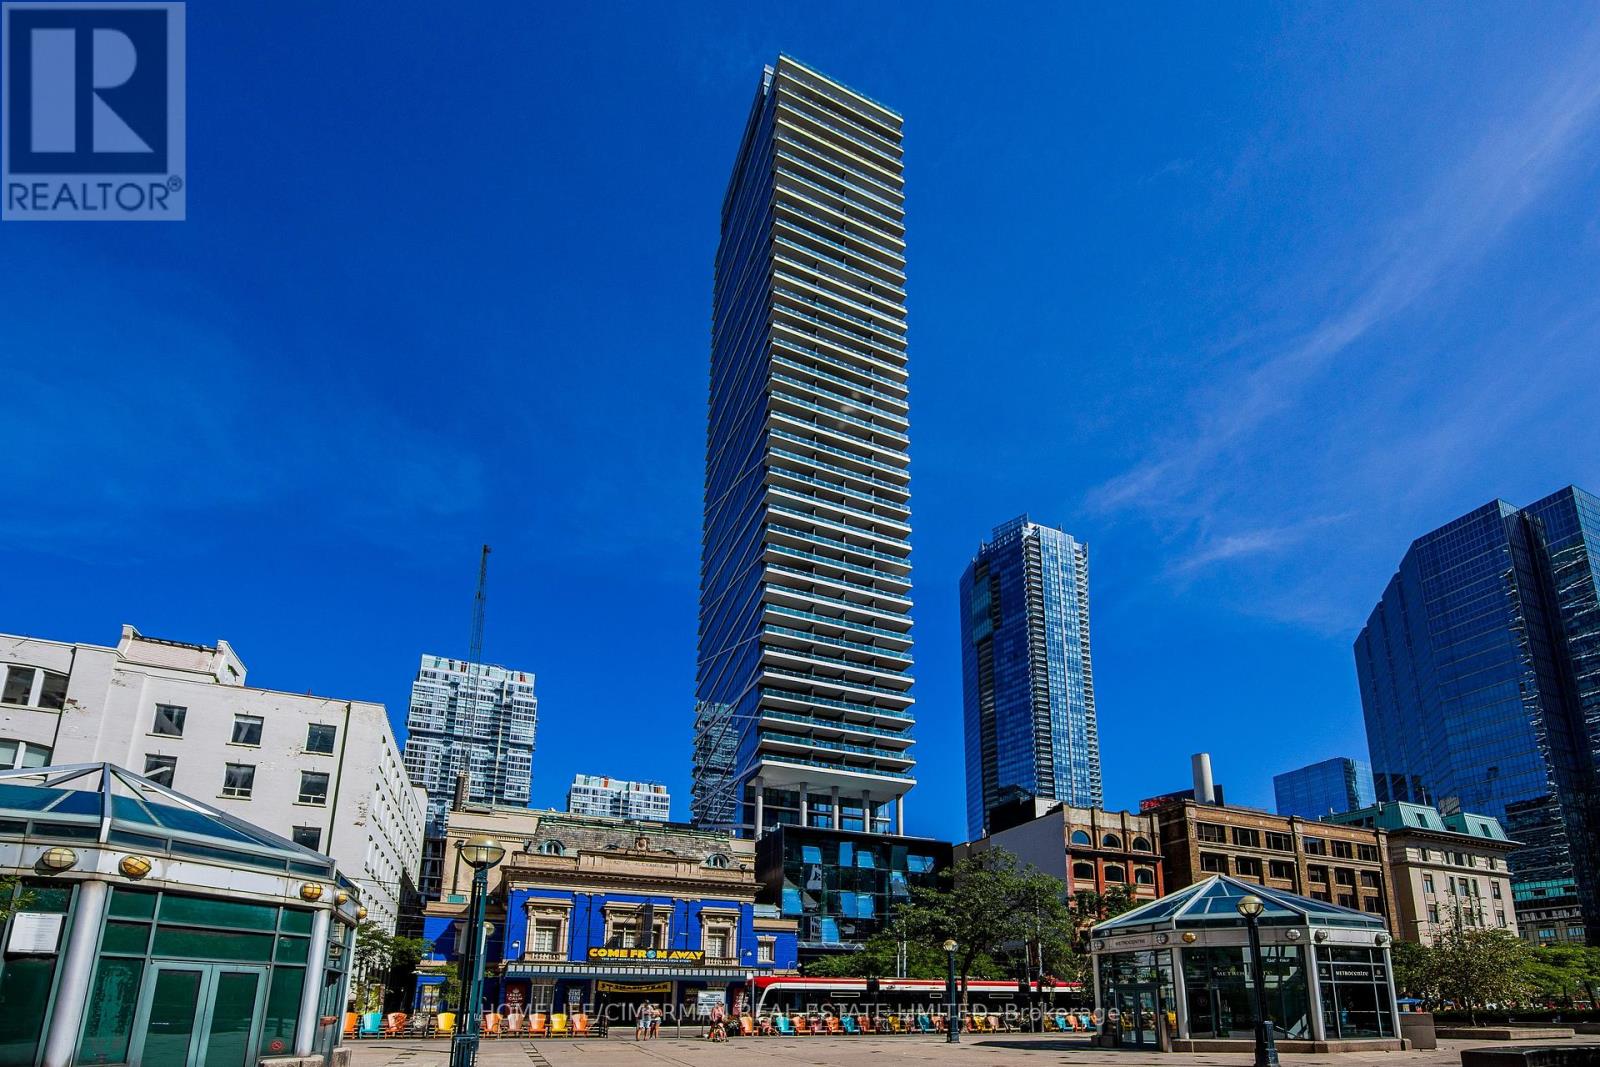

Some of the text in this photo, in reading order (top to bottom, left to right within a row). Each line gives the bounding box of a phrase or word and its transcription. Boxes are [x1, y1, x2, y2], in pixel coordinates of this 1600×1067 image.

[589, 948, 629, 958] COME
[630, 949, 668, 959] FROM
[669, 951, 704, 960] AWAY
